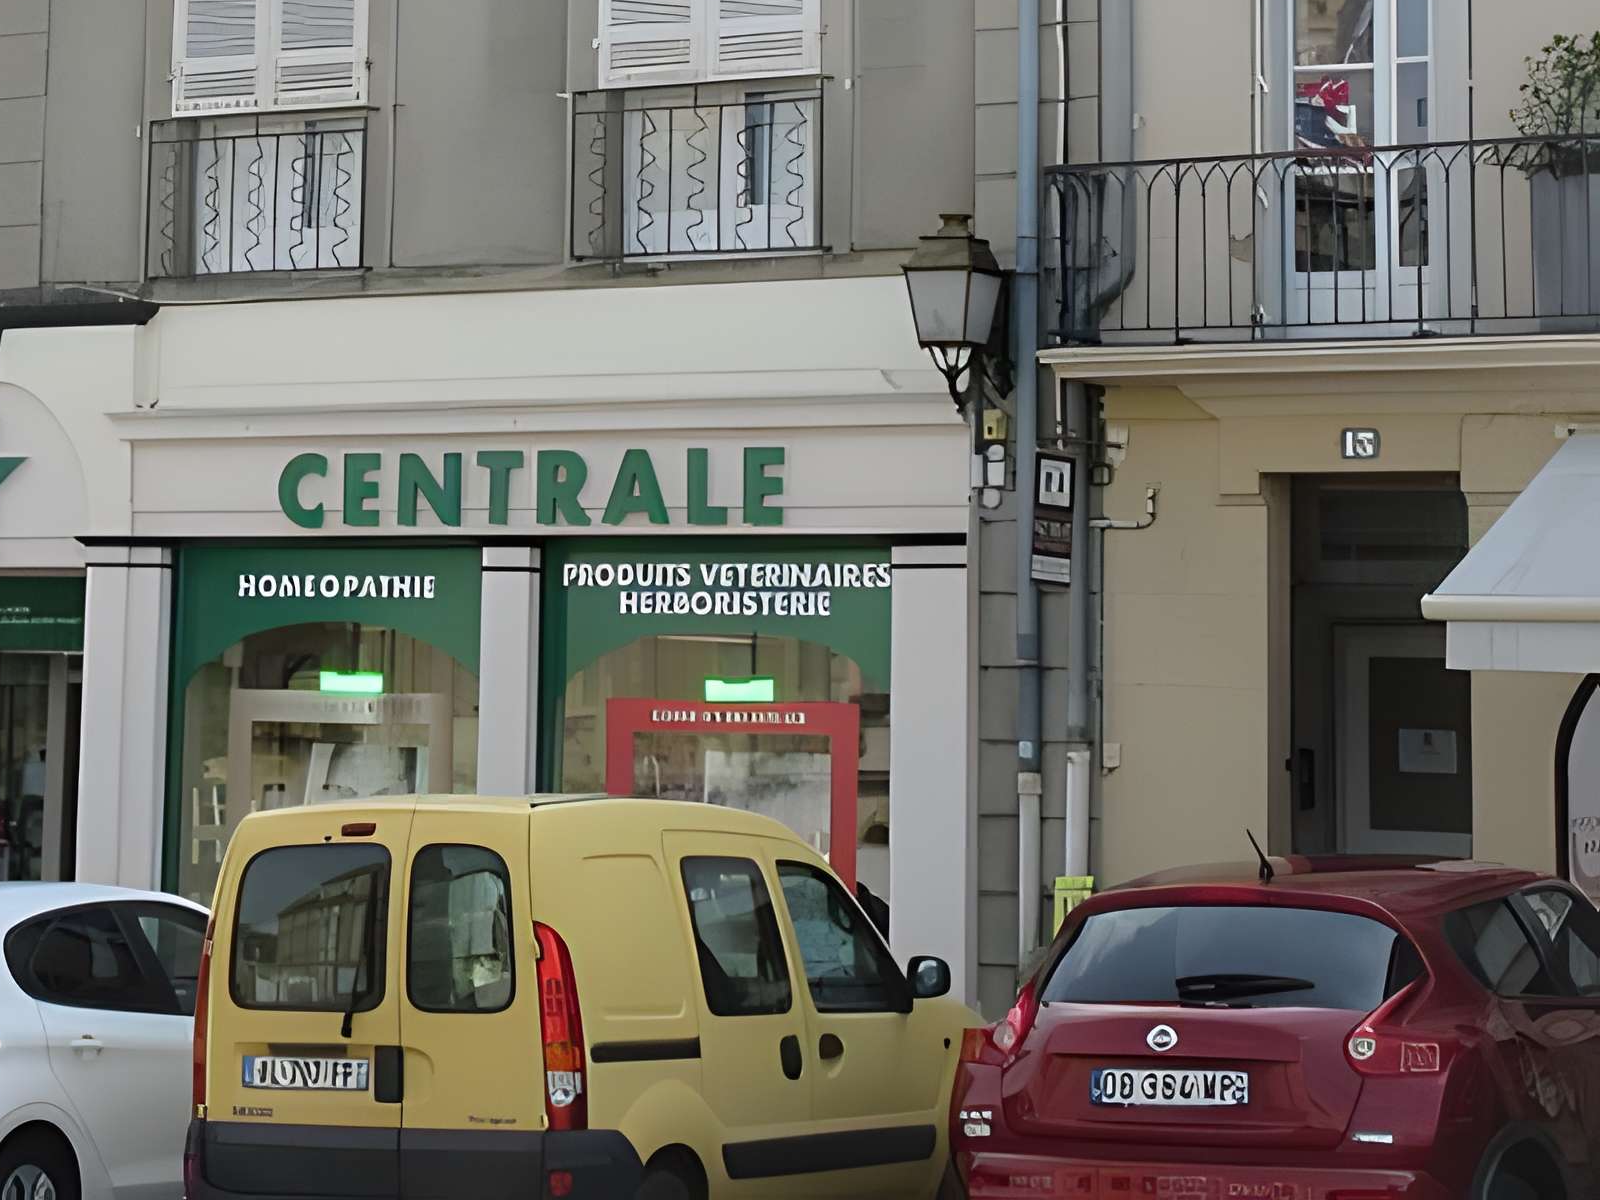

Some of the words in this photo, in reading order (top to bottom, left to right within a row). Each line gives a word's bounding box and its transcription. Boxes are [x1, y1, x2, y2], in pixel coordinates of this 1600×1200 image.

[277, 446, 786, 529] CENTRALE
[562, 562, 691, 587] PRODUITS
[699, 562, 892, 588] VETERINAIRES
[619, 590, 831, 616] HERBORISTERIE
